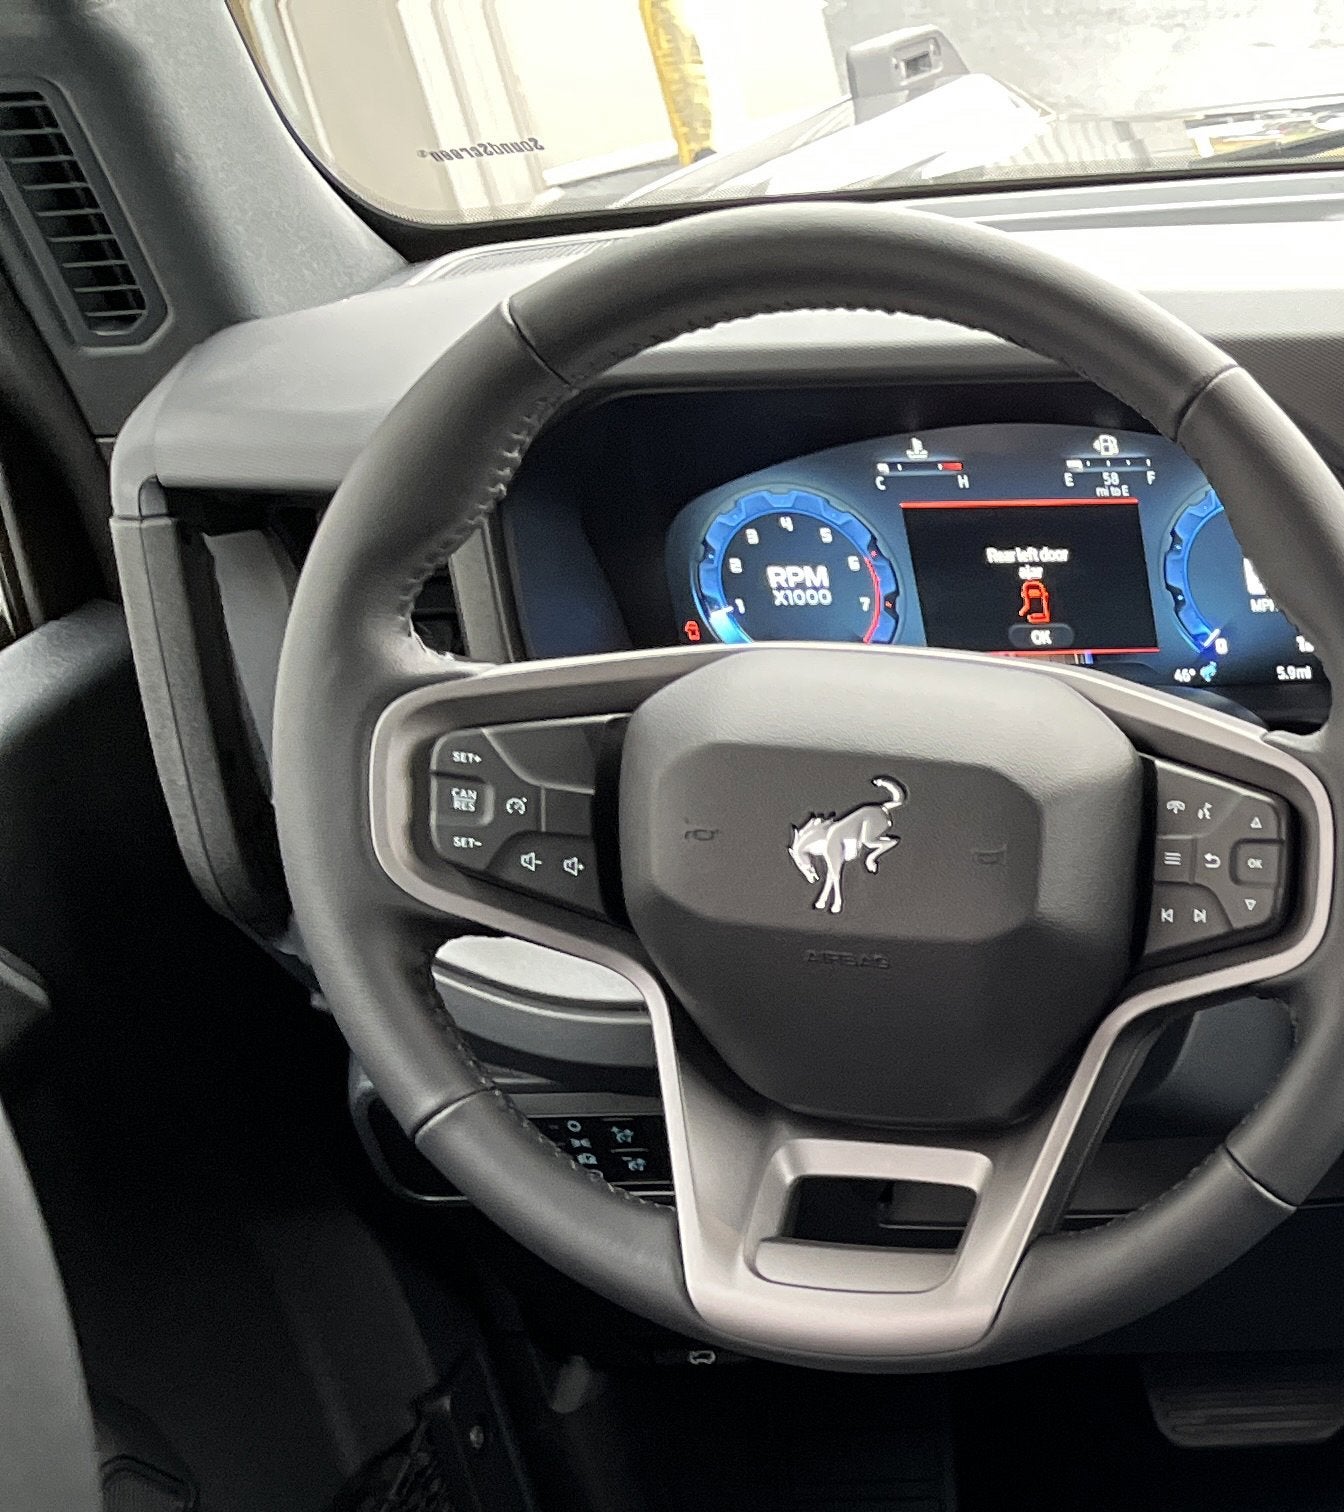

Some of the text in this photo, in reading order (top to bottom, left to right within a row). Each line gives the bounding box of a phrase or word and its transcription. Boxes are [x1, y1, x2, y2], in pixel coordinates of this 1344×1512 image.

[875, 476, 886, 491] C
[958, 474, 969, 489] H
[1064, 472, 1074, 487] E
[1102, 472, 1120, 485] 58
[1146, 470, 1156, 485] F
[779, 516, 793, 531] 4
[746, 528, 759, 544] 3
[819, 527, 832, 543] 5
[1016, 546, 1039, 562] left
[728, 558, 742, 573] 2
[848, 556, 860, 571] 6
[767, 565, 830, 588] RPM
[772, 589, 832, 606] X1000
[860, 597, 870, 611] 7
[1250, 598, 1278, 612] MP
[735, 598, 745, 614] 1
[1030, 630, 1052, 645] OK
[1216, 638, 1228, 654] 0
[451, 787, 477, 800] CAN
[1247, 858, 1263, 869] OK
